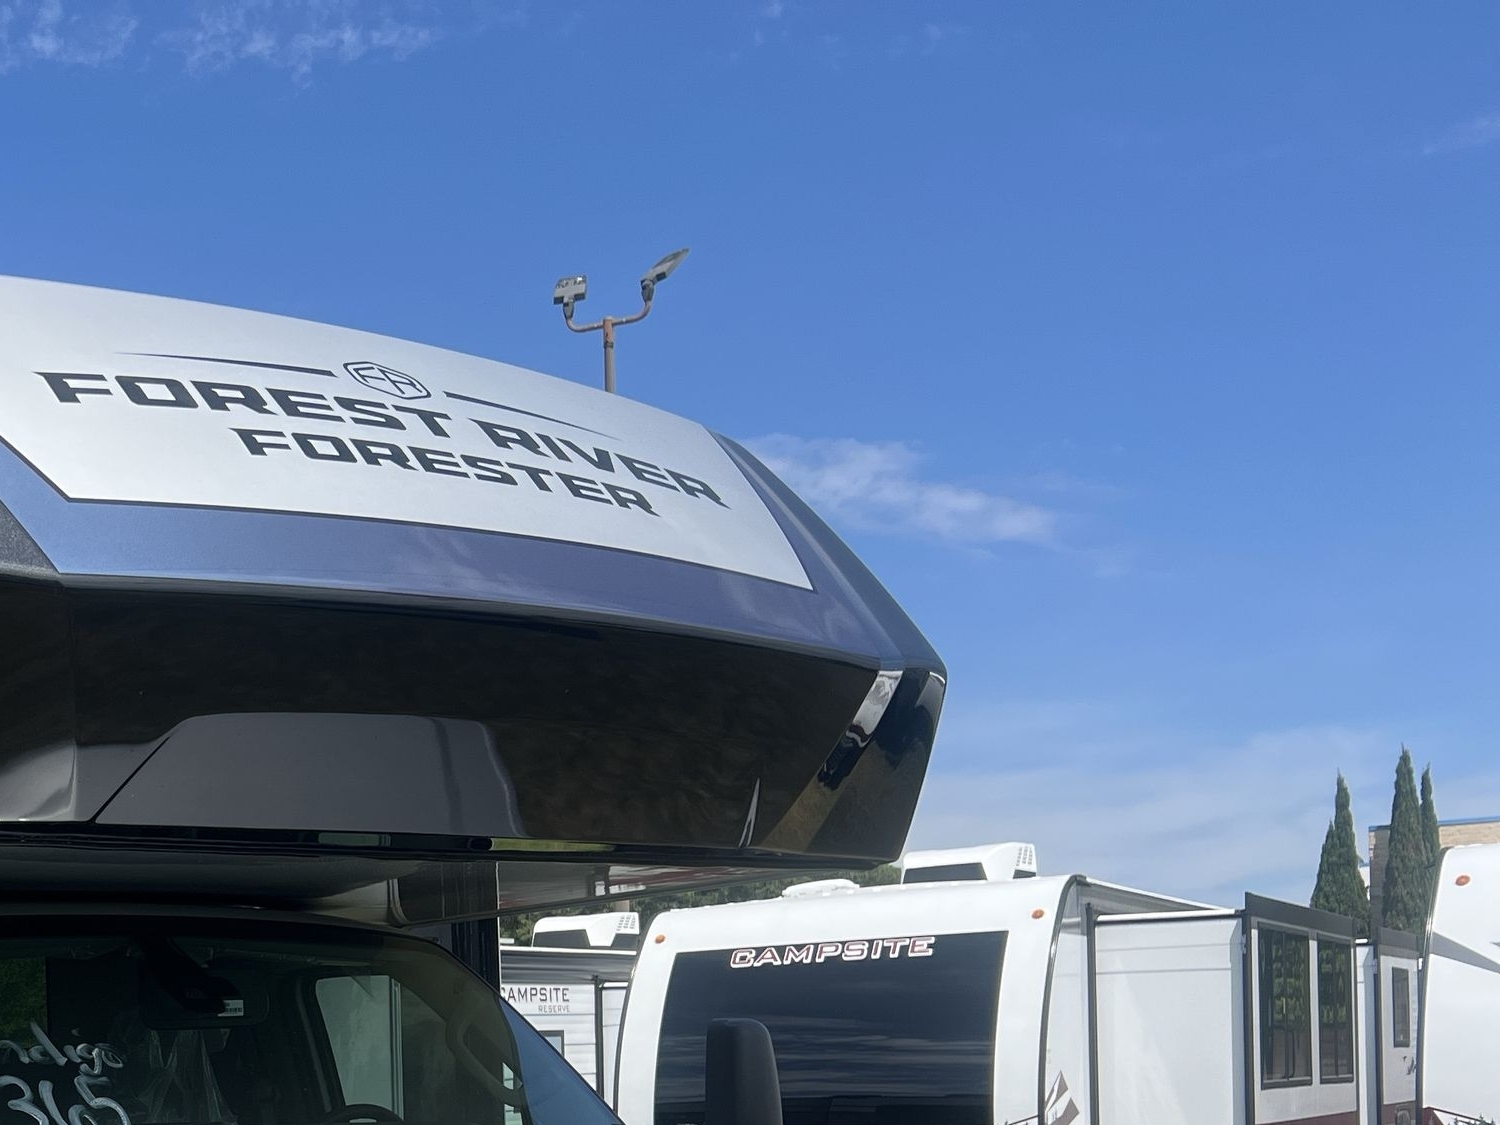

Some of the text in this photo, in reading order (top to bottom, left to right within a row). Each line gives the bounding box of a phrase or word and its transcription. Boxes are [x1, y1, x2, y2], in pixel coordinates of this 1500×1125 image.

[31, 371, 731, 509] FOREST RIVER
[228, 426, 661, 518] FORESTER
[730, 936, 936, 968] CAMPSITE
[538, 1005, 571, 1013] RESERVE
